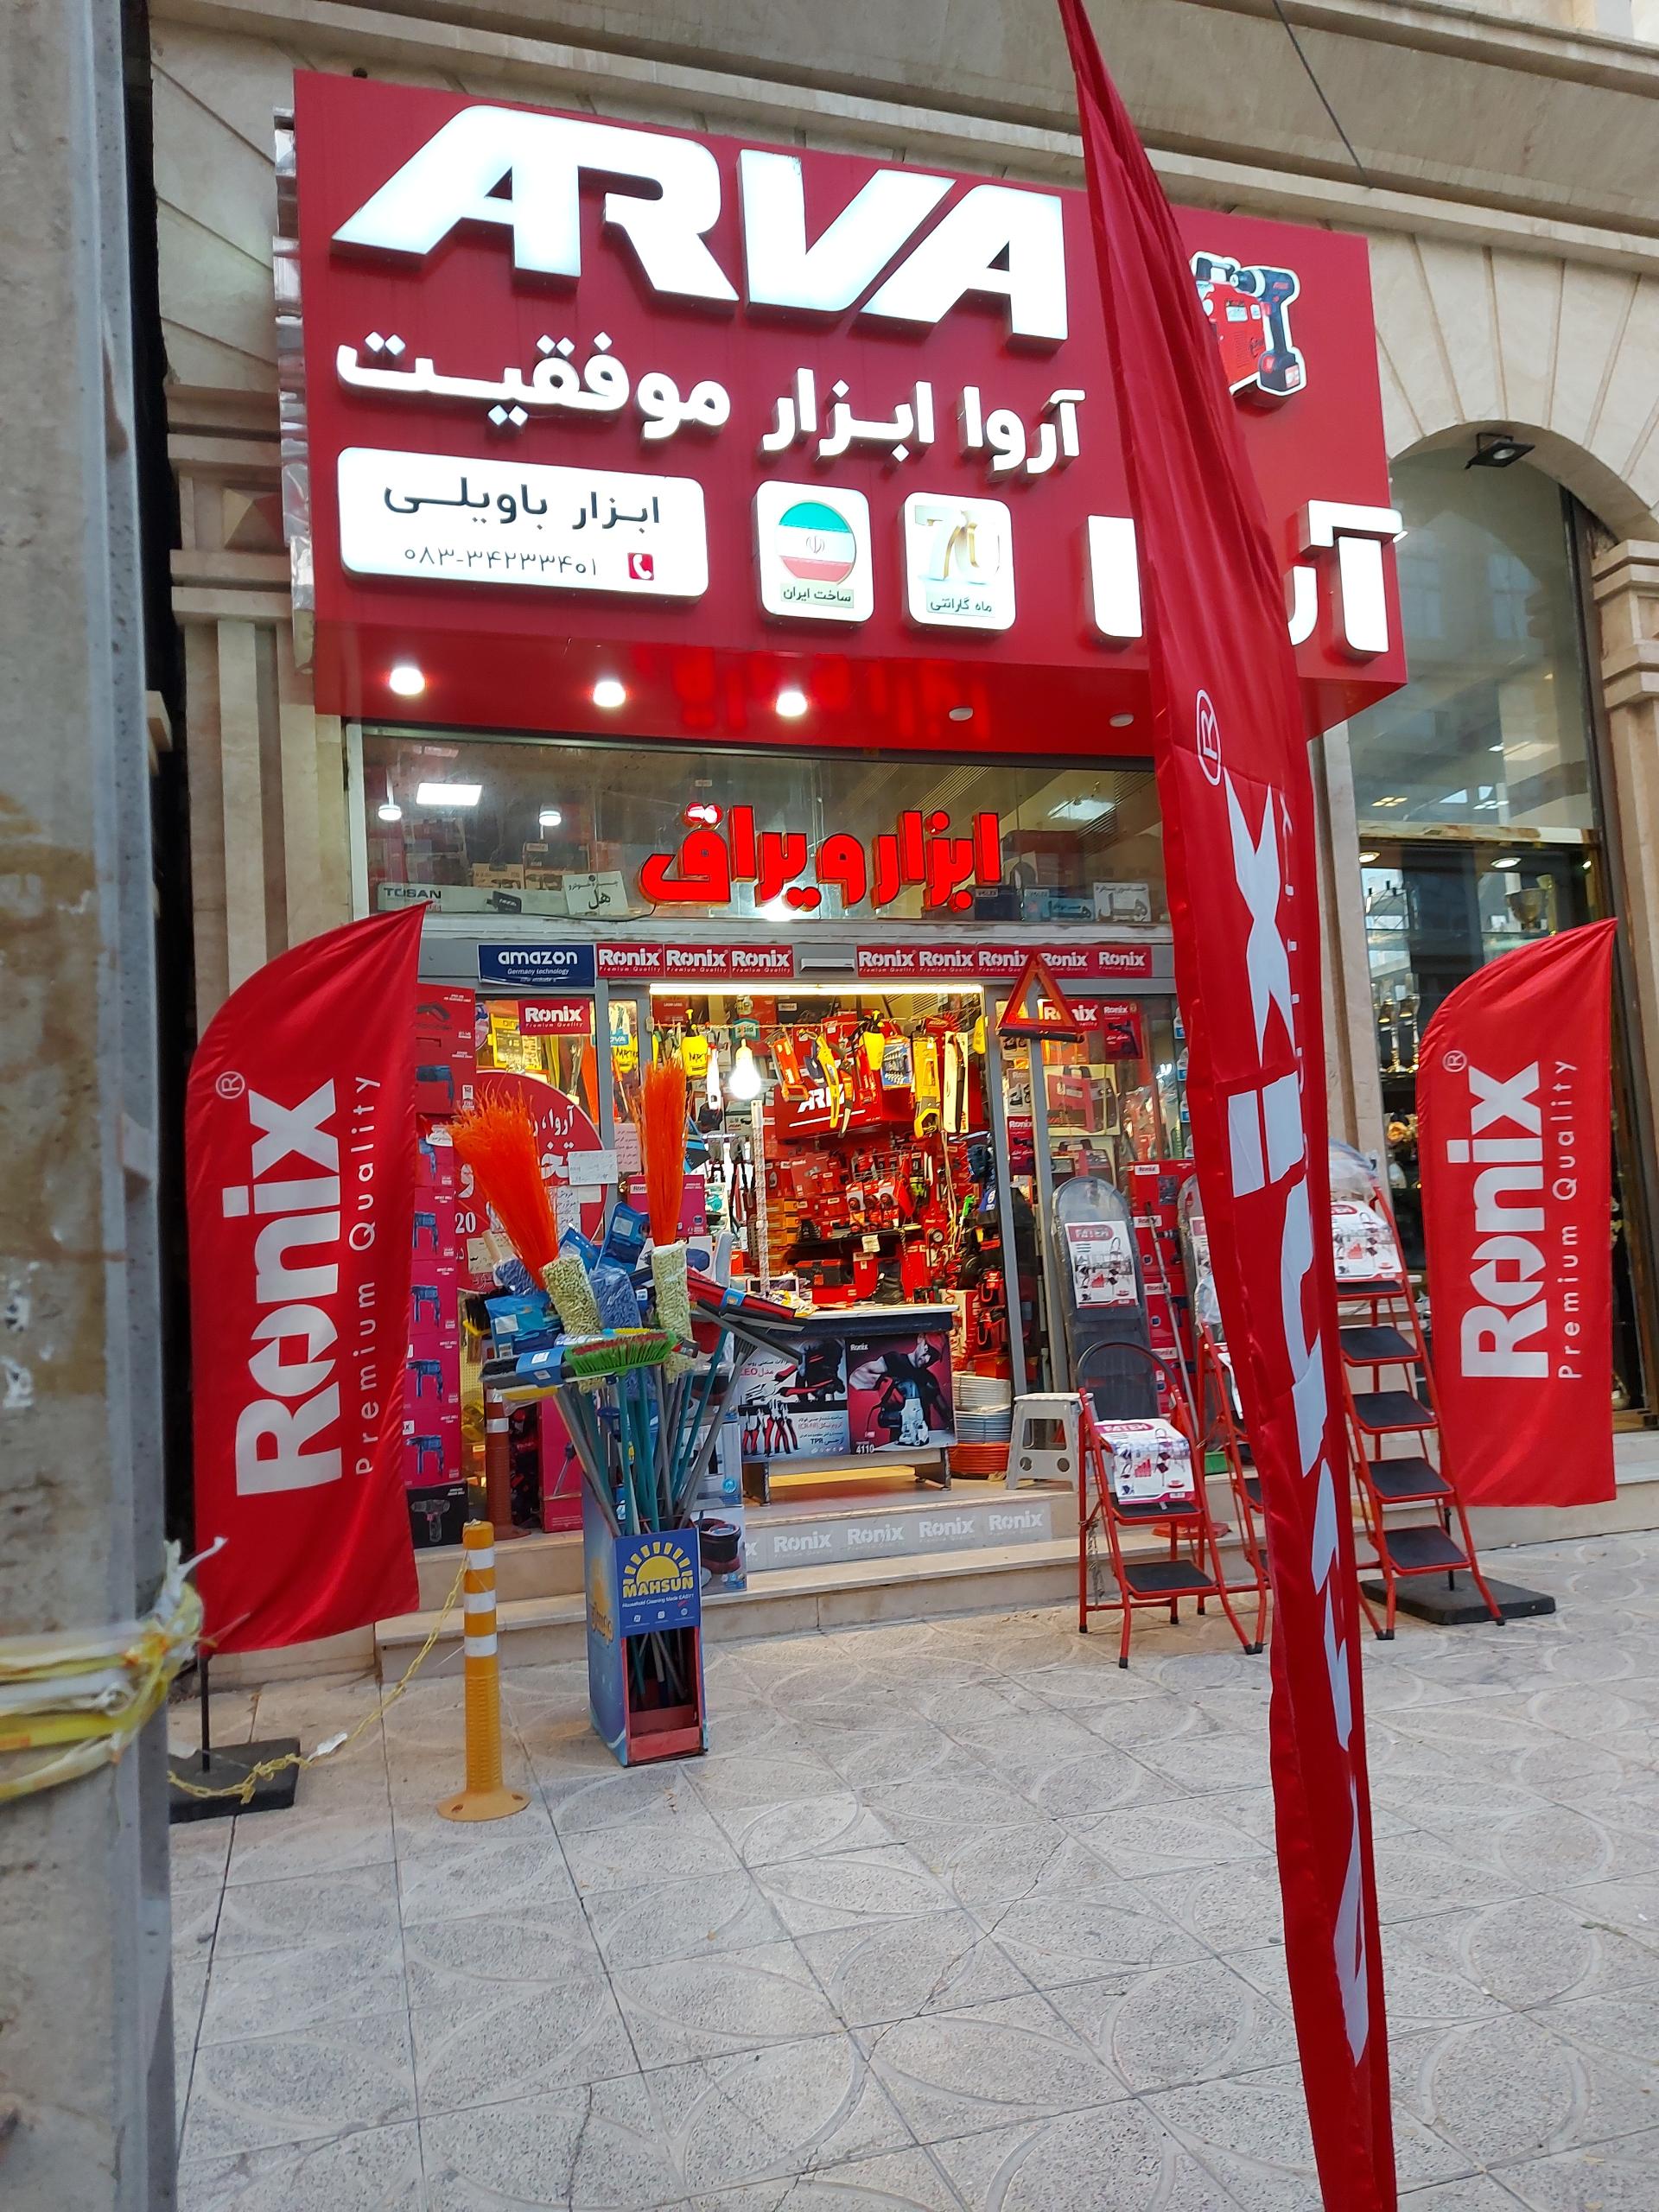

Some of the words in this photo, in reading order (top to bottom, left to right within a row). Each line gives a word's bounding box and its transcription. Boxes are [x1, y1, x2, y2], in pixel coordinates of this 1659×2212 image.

[331, 105, 1068, 340] ARVA
[335, 331, 731, 442] موفقیت
[760, 366, 935, 468] ابزار
[962, 384, 1086, 475] آروا
[384, 476, 548, 531] باویلی
[572, 491, 659, 534] ابزار
[784, 587, 810, 602] ایران
[814, 589, 852, 602] ساخت
[931, 596, 970, 612] گارانتی
[976, 601, 993, 613] ماه
[639, 803, 823, 911] یراق
[875, 810, 1001, 911] ابزار
[384, 887, 442, 899] TOSAN
[498, 951, 578, 965] amazon
[599, 948, 661, 966] Ronix
[666, 949, 727, 967] Ronix
[732, 950, 791, 967] Ronix
[859, 950, 914, 967] Ronix
[919, 950, 974, 967] Ronix
[1098, 951, 1146, 967] Ronix
[525, 1006, 583, 1023] Ronix
[1552, 1059, 1580, 1201] Quality
[349, 1076, 381, 1252] Quality
[454, 1211, 476, 1233] 20
[1447, 1061, 1549, 1379] Ronix
[221, 1077, 342, 1497] Ronix
[1559, 1224, 1580, 1379] Premium
[356, 1281, 378, 1475] Premium
[774, 1531, 832, 1553] Ronix
[847, 1523, 905, 1546] Ronix
[918, 1516, 975, 1538] Ronix
[988, 1510, 1044, 1530] Ronix
[623, 1575, 694, 1599] MAHSUN
